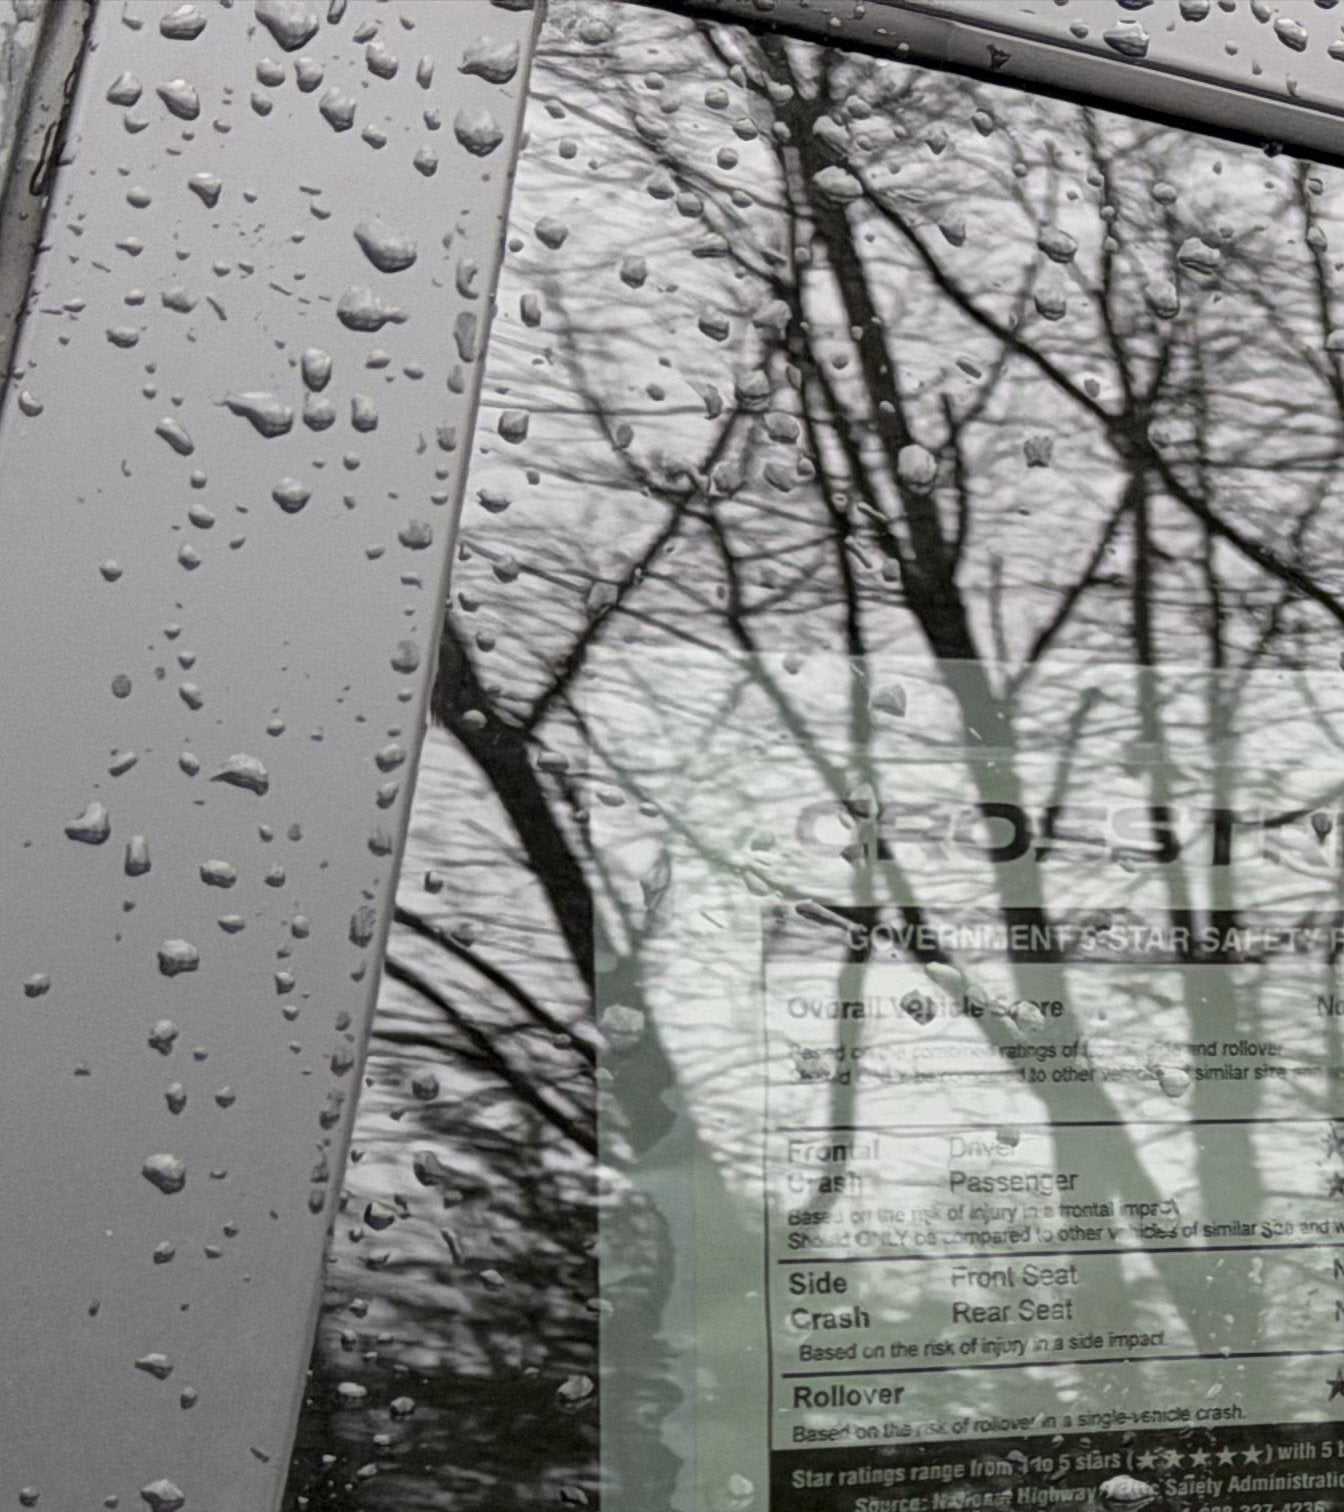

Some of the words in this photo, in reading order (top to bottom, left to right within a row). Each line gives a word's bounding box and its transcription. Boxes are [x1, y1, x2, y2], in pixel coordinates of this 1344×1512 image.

[789, 1271, 847, 1295] Side
[951, 1267, 1014, 1287] Front
[1021, 1264, 1079, 1286] Seat
[789, 1307, 870, 1330] Crash
[952, 1301, 1010, 1323] Rear
[1018, 1299, 1073, 1320] Seat
[792, 1384, 905, 1409] Rollover
